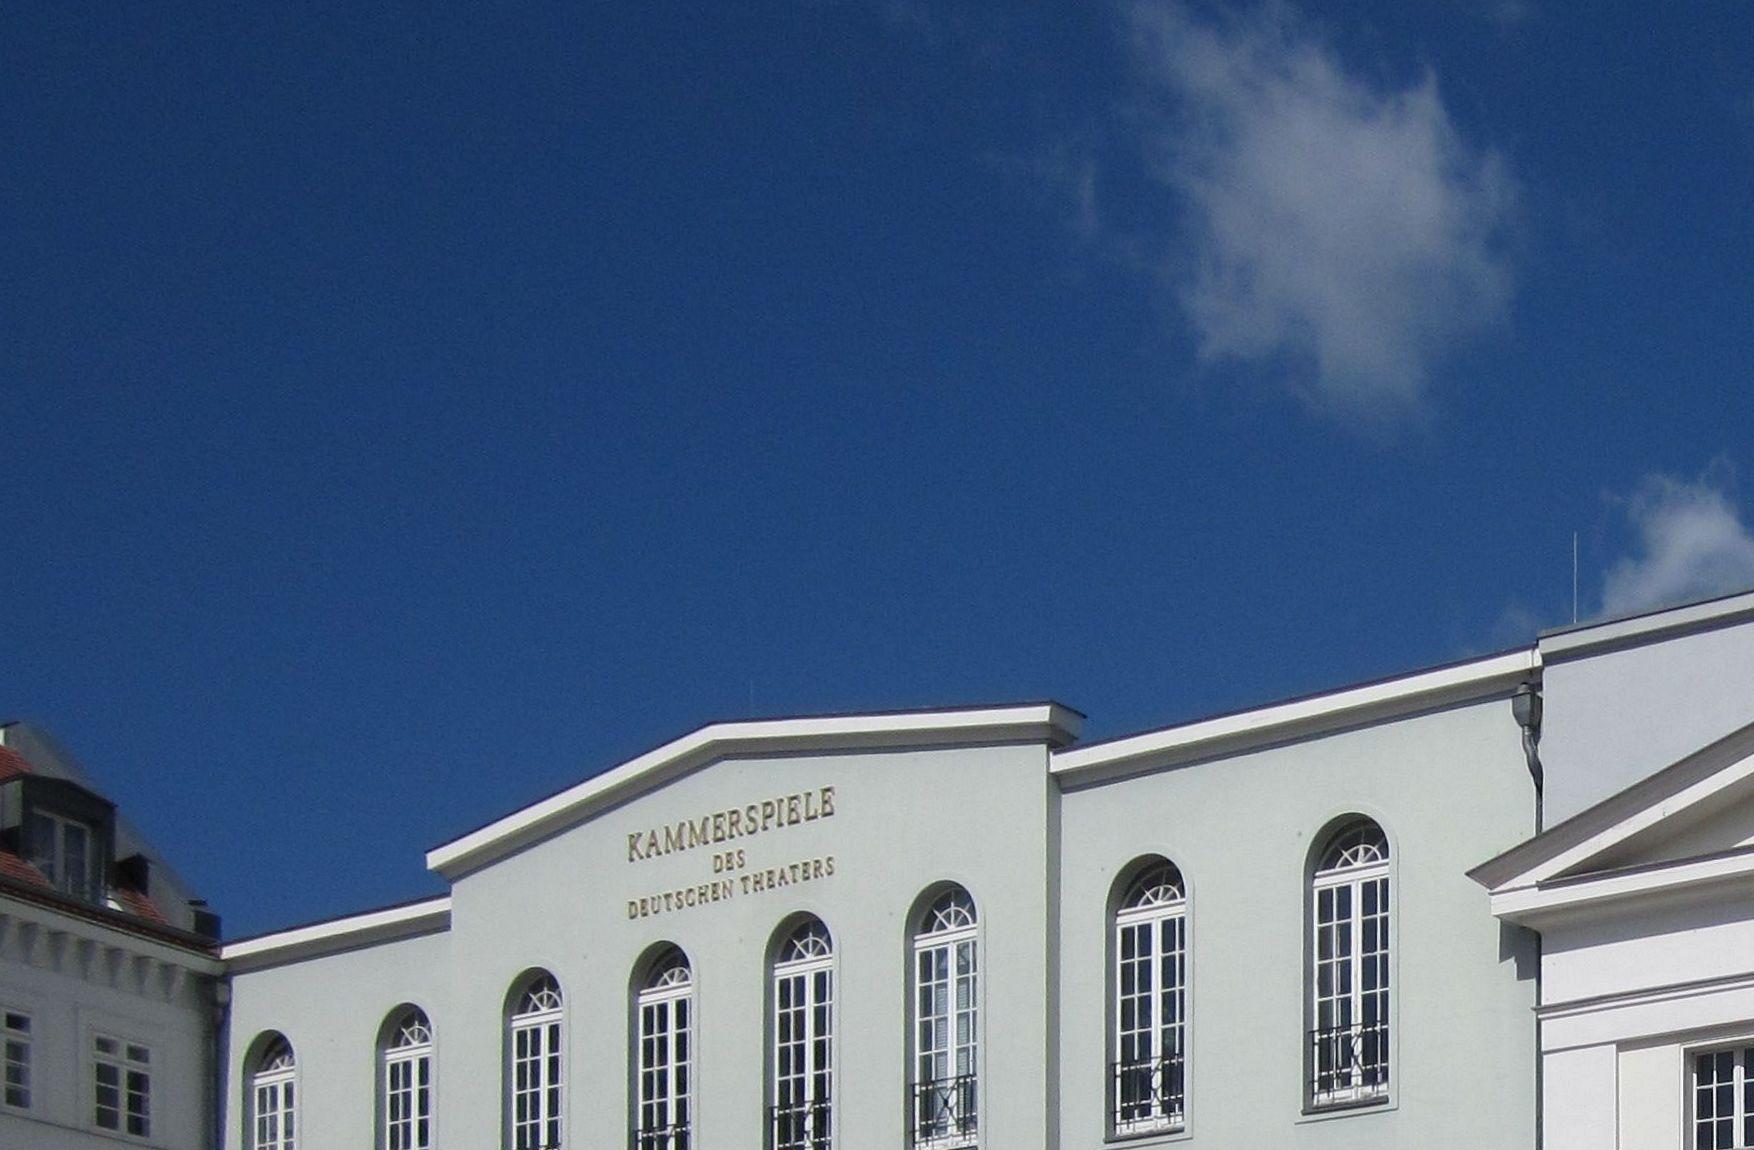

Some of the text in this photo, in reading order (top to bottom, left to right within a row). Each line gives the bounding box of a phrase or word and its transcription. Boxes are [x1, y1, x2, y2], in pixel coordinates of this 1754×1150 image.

[627, 786, 835, 862] KAMMERSPIELE
[628, 856, 834, 919] DEUTSCHEN THEATERS
[713, 850, 746, 873] DES
